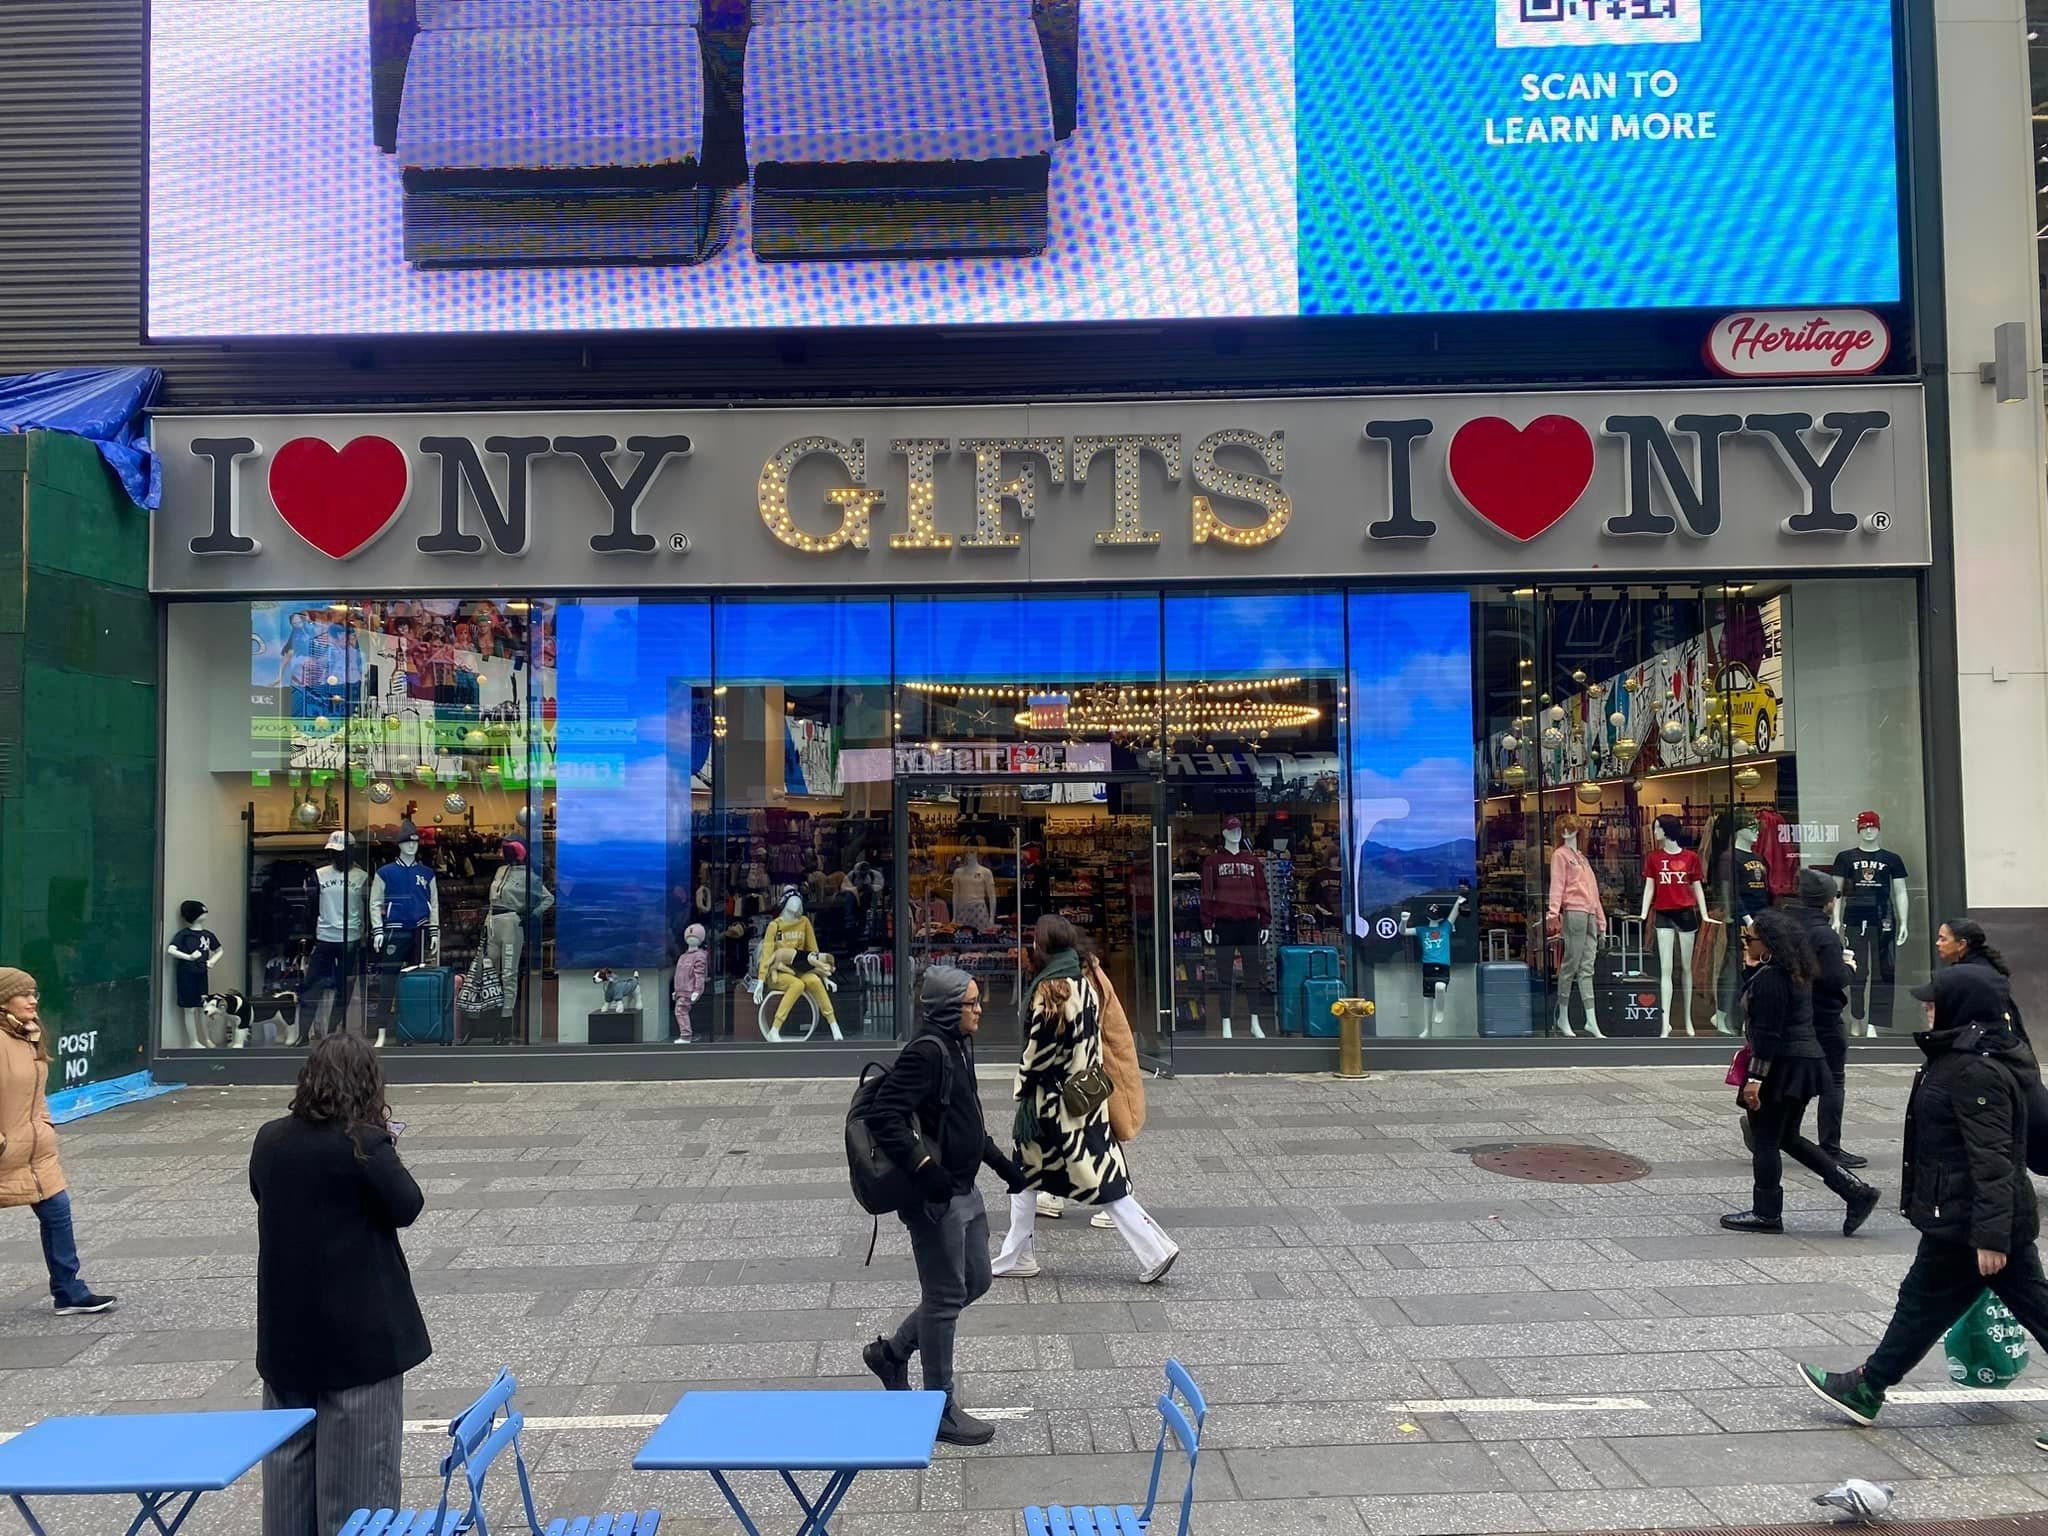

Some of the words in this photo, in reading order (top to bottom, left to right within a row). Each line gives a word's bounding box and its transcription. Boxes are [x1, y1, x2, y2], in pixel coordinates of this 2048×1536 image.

[1521, 72, 1617, 101] SCAN
[1626, 69, 1678, 98] TO
[1485, 115, 1599, 145] LEARN
[1611, 112, 1717, 141] MORE
[1727, 317, 1874, 367] Heritage
[757, 428, 1293, 552] GIFTS
[1364, 418, 1437, 539] I
[189, 436, 261, 555] I
[1661, 859, 1670, 871] I
[1853, 860, 1886, 870] FDNY
[1658, 871, 1688, 884] NY
[1628, 993, 1638, 1006] I
[1624, 1007, 1659, 1020] NY
[58, 1031, 98, 1055] POST
[65, 1058, 88, 1080] NO
